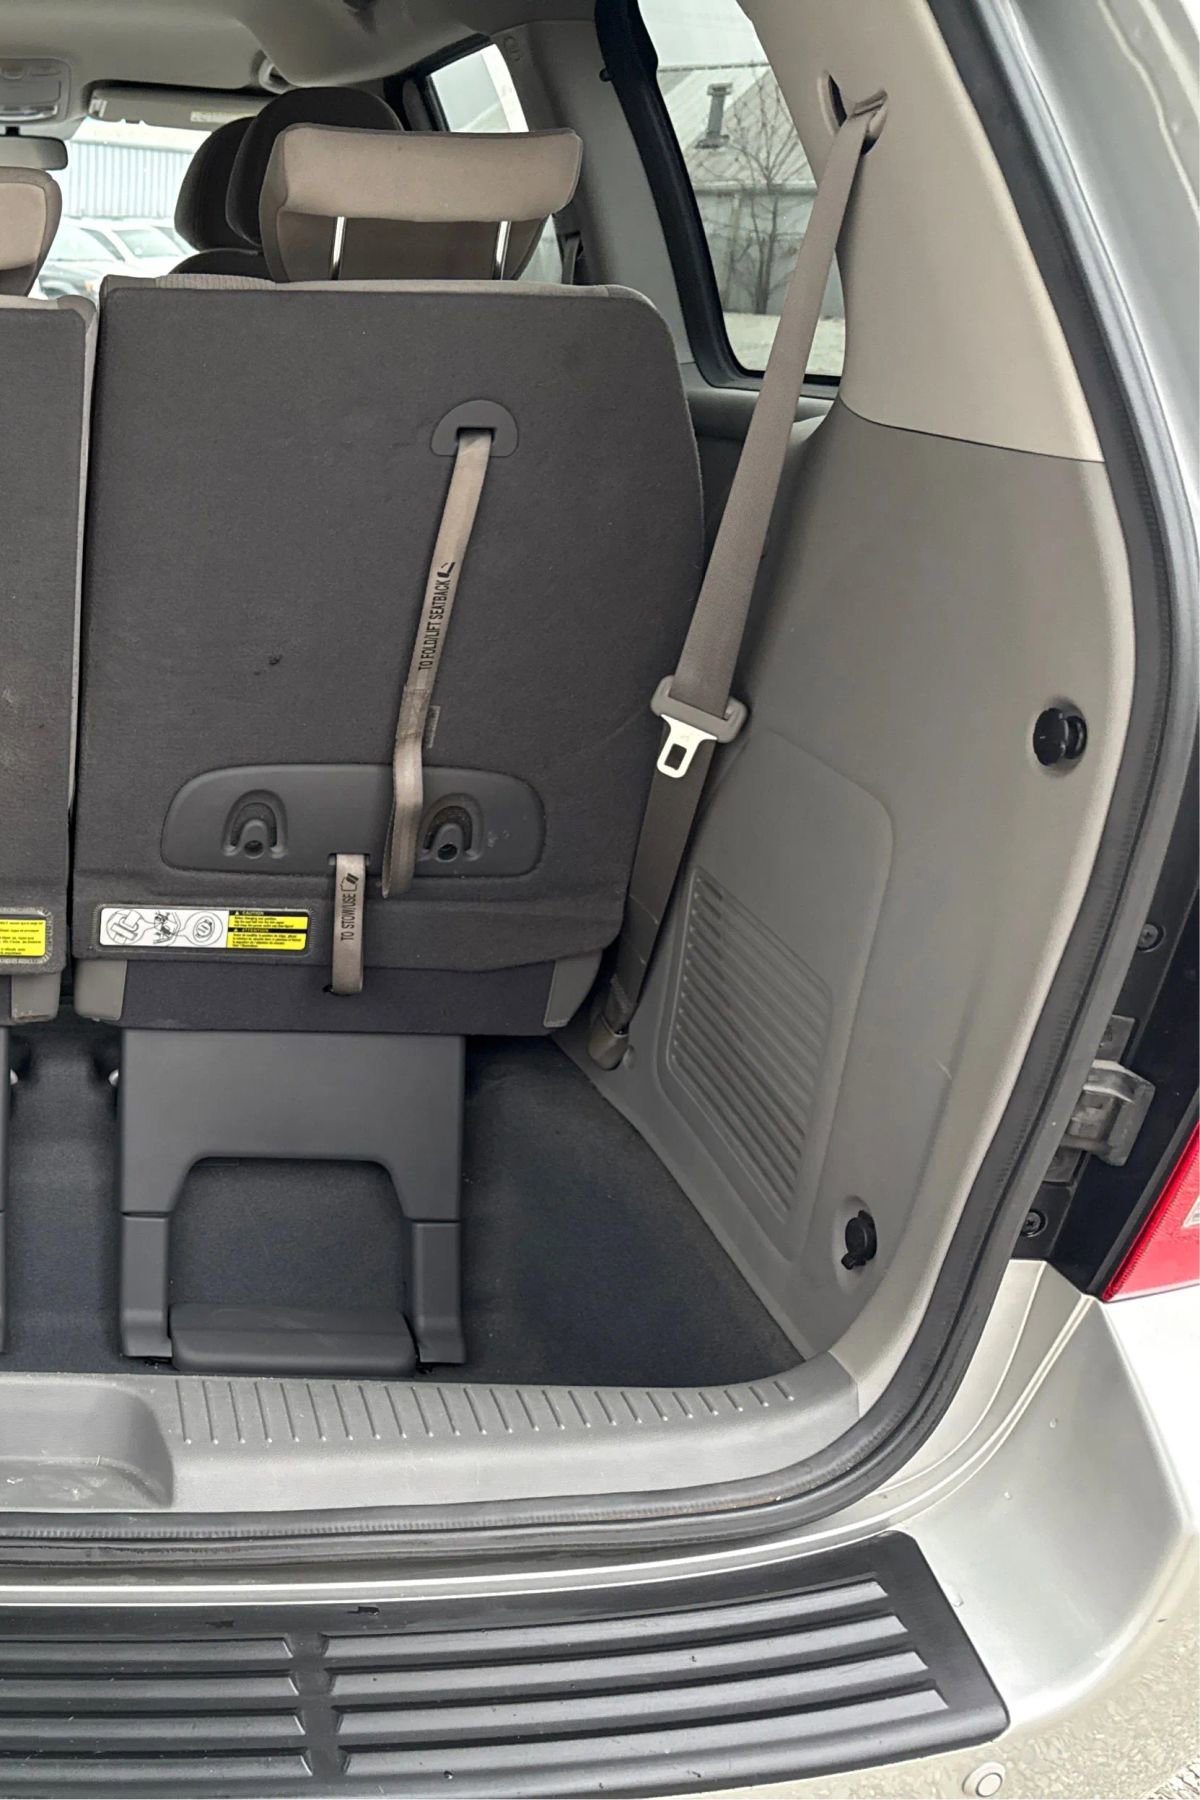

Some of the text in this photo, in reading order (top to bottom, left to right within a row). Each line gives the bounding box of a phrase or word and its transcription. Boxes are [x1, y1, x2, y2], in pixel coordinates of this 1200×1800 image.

[418, 579, 450, 671] TO FOLD/LIFT SEATBACK
[340, 893, 357, 942] TO STOW/USE
